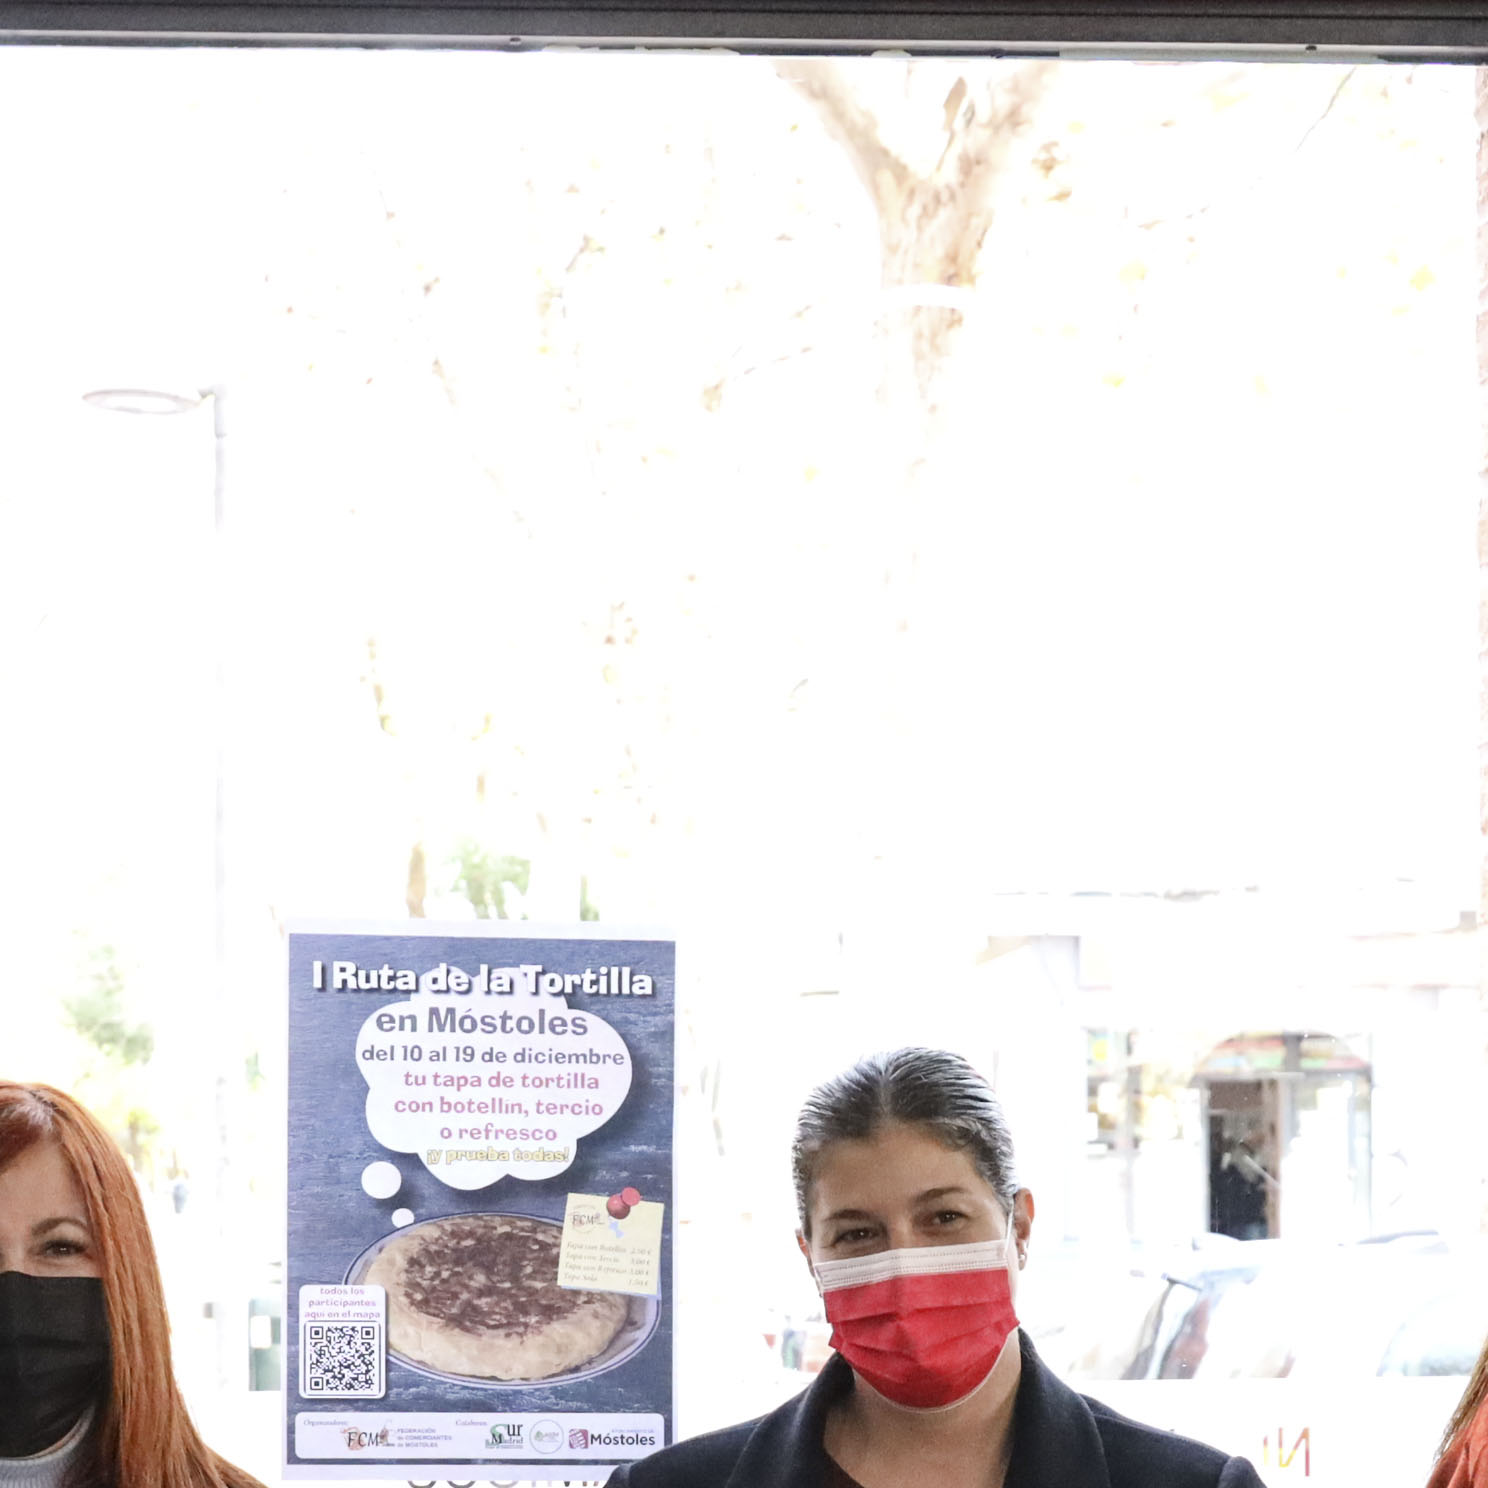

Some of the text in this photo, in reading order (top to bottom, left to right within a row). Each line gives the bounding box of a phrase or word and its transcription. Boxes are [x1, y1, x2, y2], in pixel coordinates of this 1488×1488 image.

[313, 960, 653, 995] I Ruta de la Tortilla
[376, 1006, 588, 1036] en Móstoles
[361, 1045, 624, 1066] del 10 al 19 de diciembre
[404, 1072, 599, 1092] tu tapa de tortilla
[394, 1101, 433, 1115] con
[536, 1100, 603, 1116] tercio
[440, 1123, 557, 1142] o refresco
[446, 1148, 509, 1166] prueba
[513, 1147, 570, 1164] todas!
[308, 1298, 376, 1308] participantes
[342, 1310, 351, 1318] el
[353, 1312, 380, 1320] mapa
[591, 1433, 656, 1447] Móstoles
